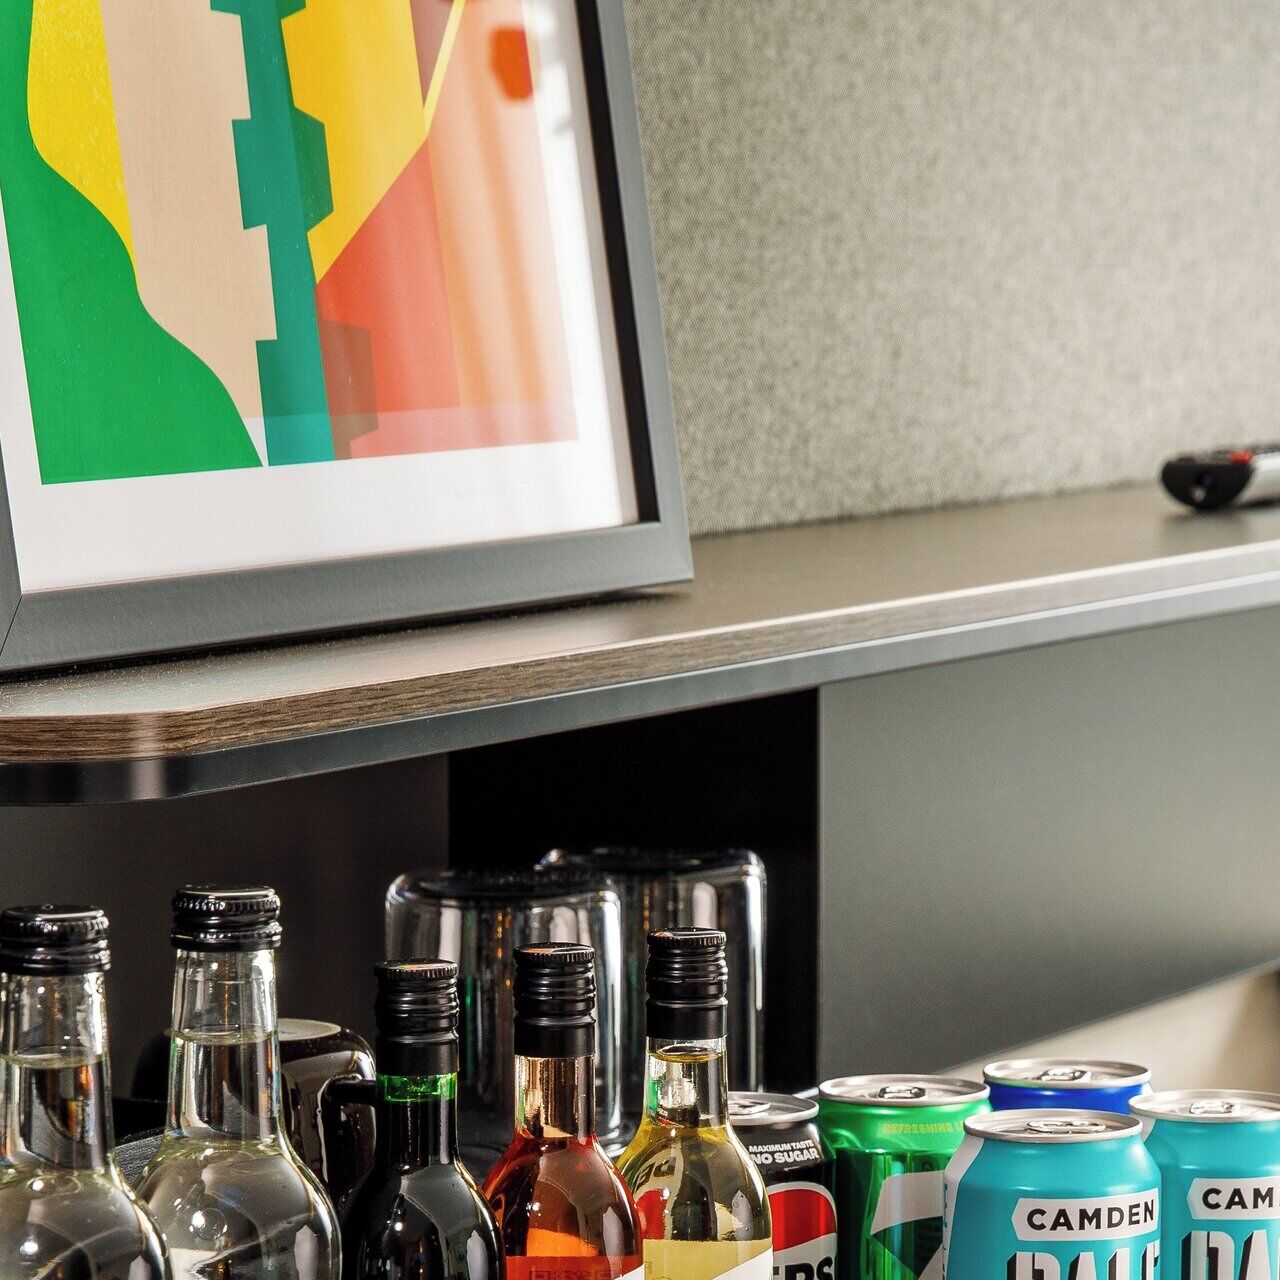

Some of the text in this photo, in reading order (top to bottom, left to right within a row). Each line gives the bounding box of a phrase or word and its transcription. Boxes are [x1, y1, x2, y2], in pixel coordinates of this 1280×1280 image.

[749, 1139, 813, 1153] MAXIMUM TASTE
[751, 1148, 819, 1165] NO SUGAR
[1026, 1199, 1155, 1232] CAMDEN
